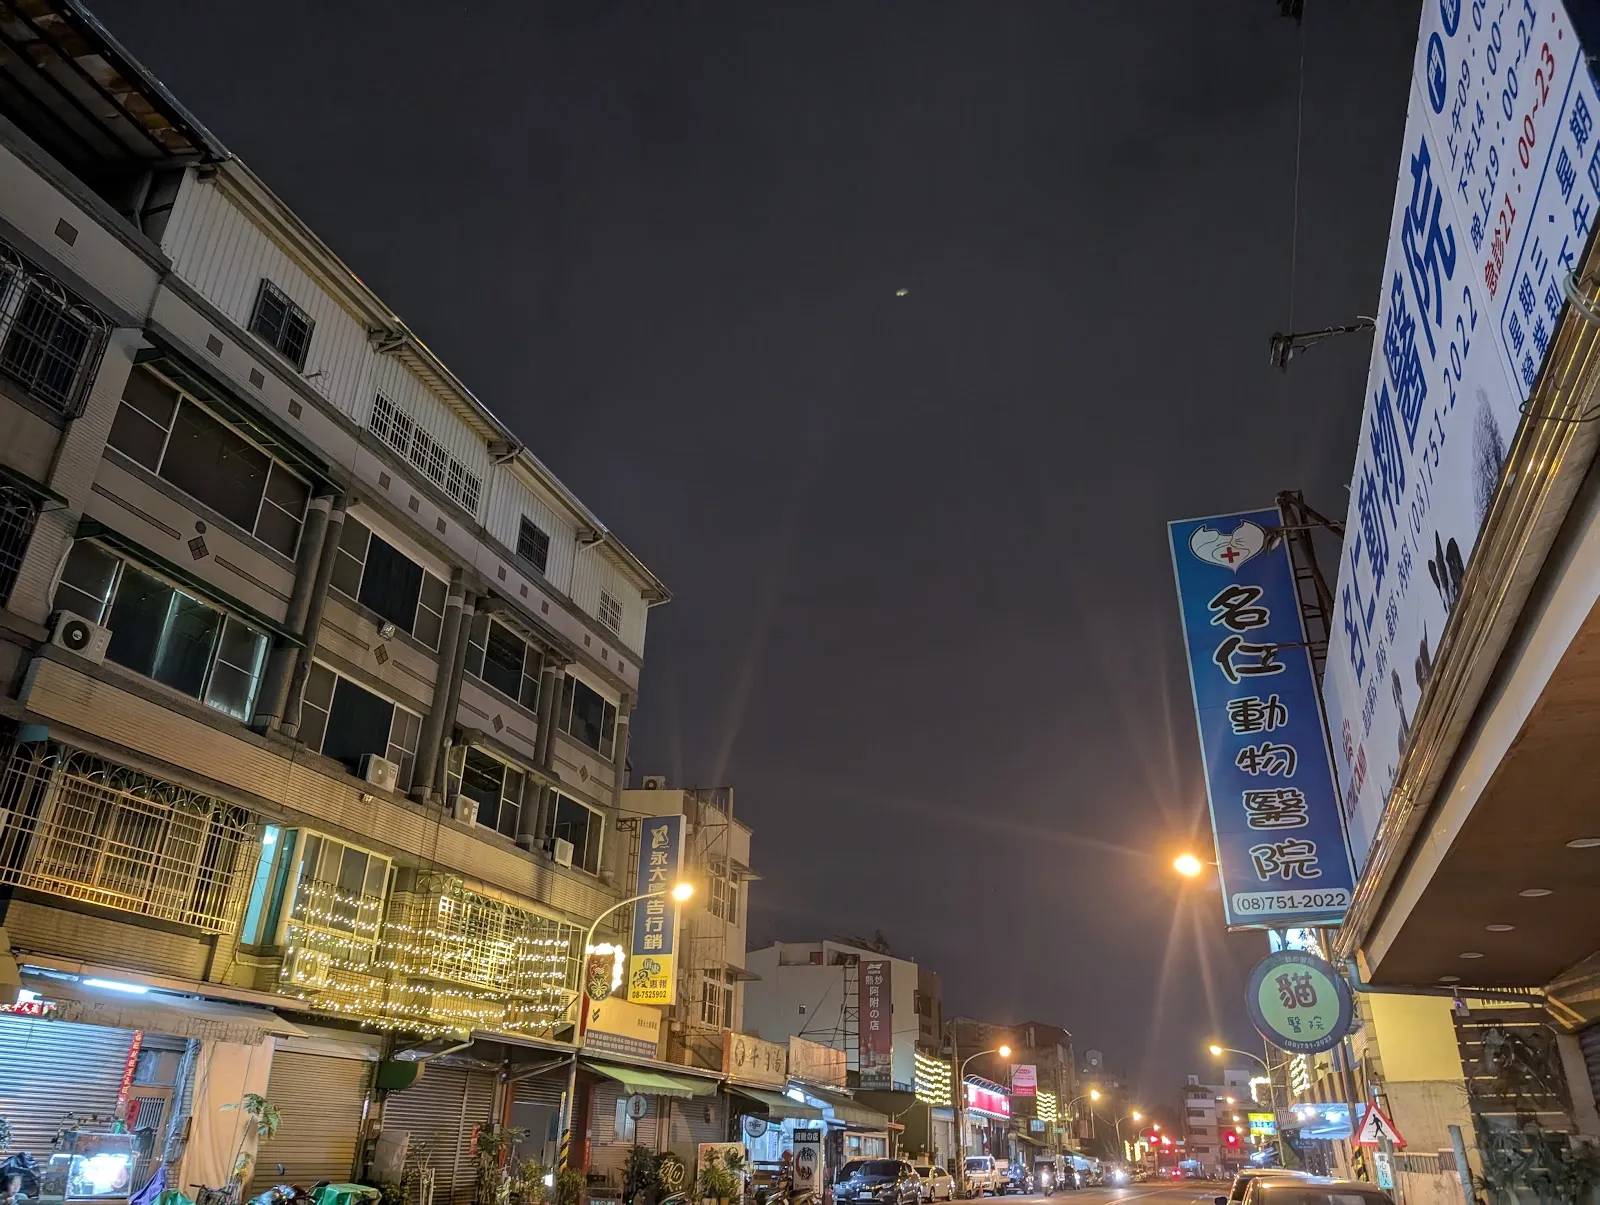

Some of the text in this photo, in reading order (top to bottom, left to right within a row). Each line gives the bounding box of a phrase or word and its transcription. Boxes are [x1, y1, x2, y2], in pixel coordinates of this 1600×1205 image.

[1342, 133, 1456, 688] 名仁動物醫院
[1408, 284, 1478, 553] (08)751-2022
[1208, 584, 1322, 882] 名仁動物醫院
[643, 851, 668, 950] 永大廣告行銷
[1235, 890, 1348, 913] (08)751-2022
[869, 986, 880, 1031] 阿附の店
[1275, 971, 1317, 1010] 貓
[1287, 1015, 1324, 1034] 醫院
